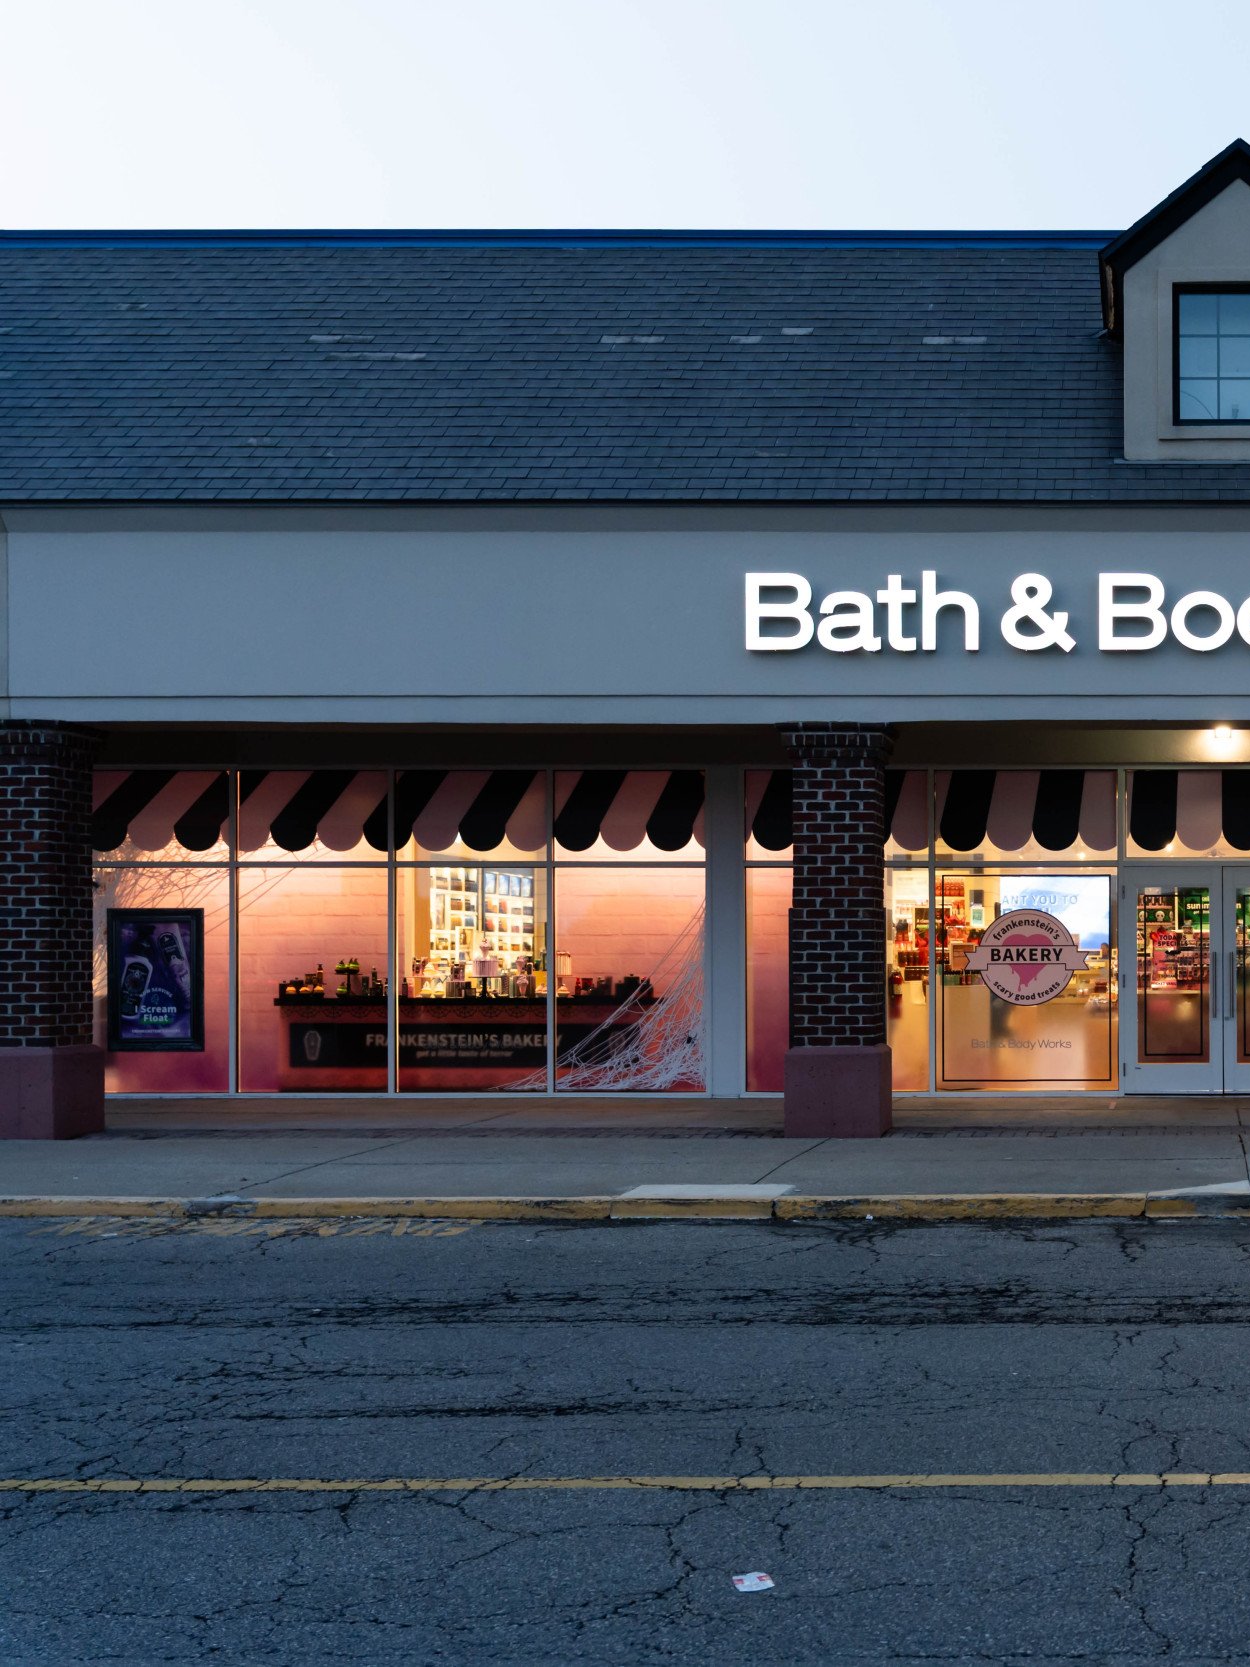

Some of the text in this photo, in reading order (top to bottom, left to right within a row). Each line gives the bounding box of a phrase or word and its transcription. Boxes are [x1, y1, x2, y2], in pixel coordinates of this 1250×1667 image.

[744, 570, 980, 652] Bath
[1000, 572, 1076, 653] &
[1002, 895, 1078, 905] ANT YOU TO
[992, 918, 1061, 941] frankenstein's
[990, 948, 1063, 962] BAKERY
[993, 981, 1061, 1001] scary good treats
[140, 1005, 177, 1013] Scream
[143, 1013, 169, 1022] Float
[366, 1033, 498, 1047] FRNKENSTEIN'S
[971, 1038, 996, 1048] Bat
[1007, 1038, 1036, 1050] Body
[1037, 1038, 1072, 1048] Works
